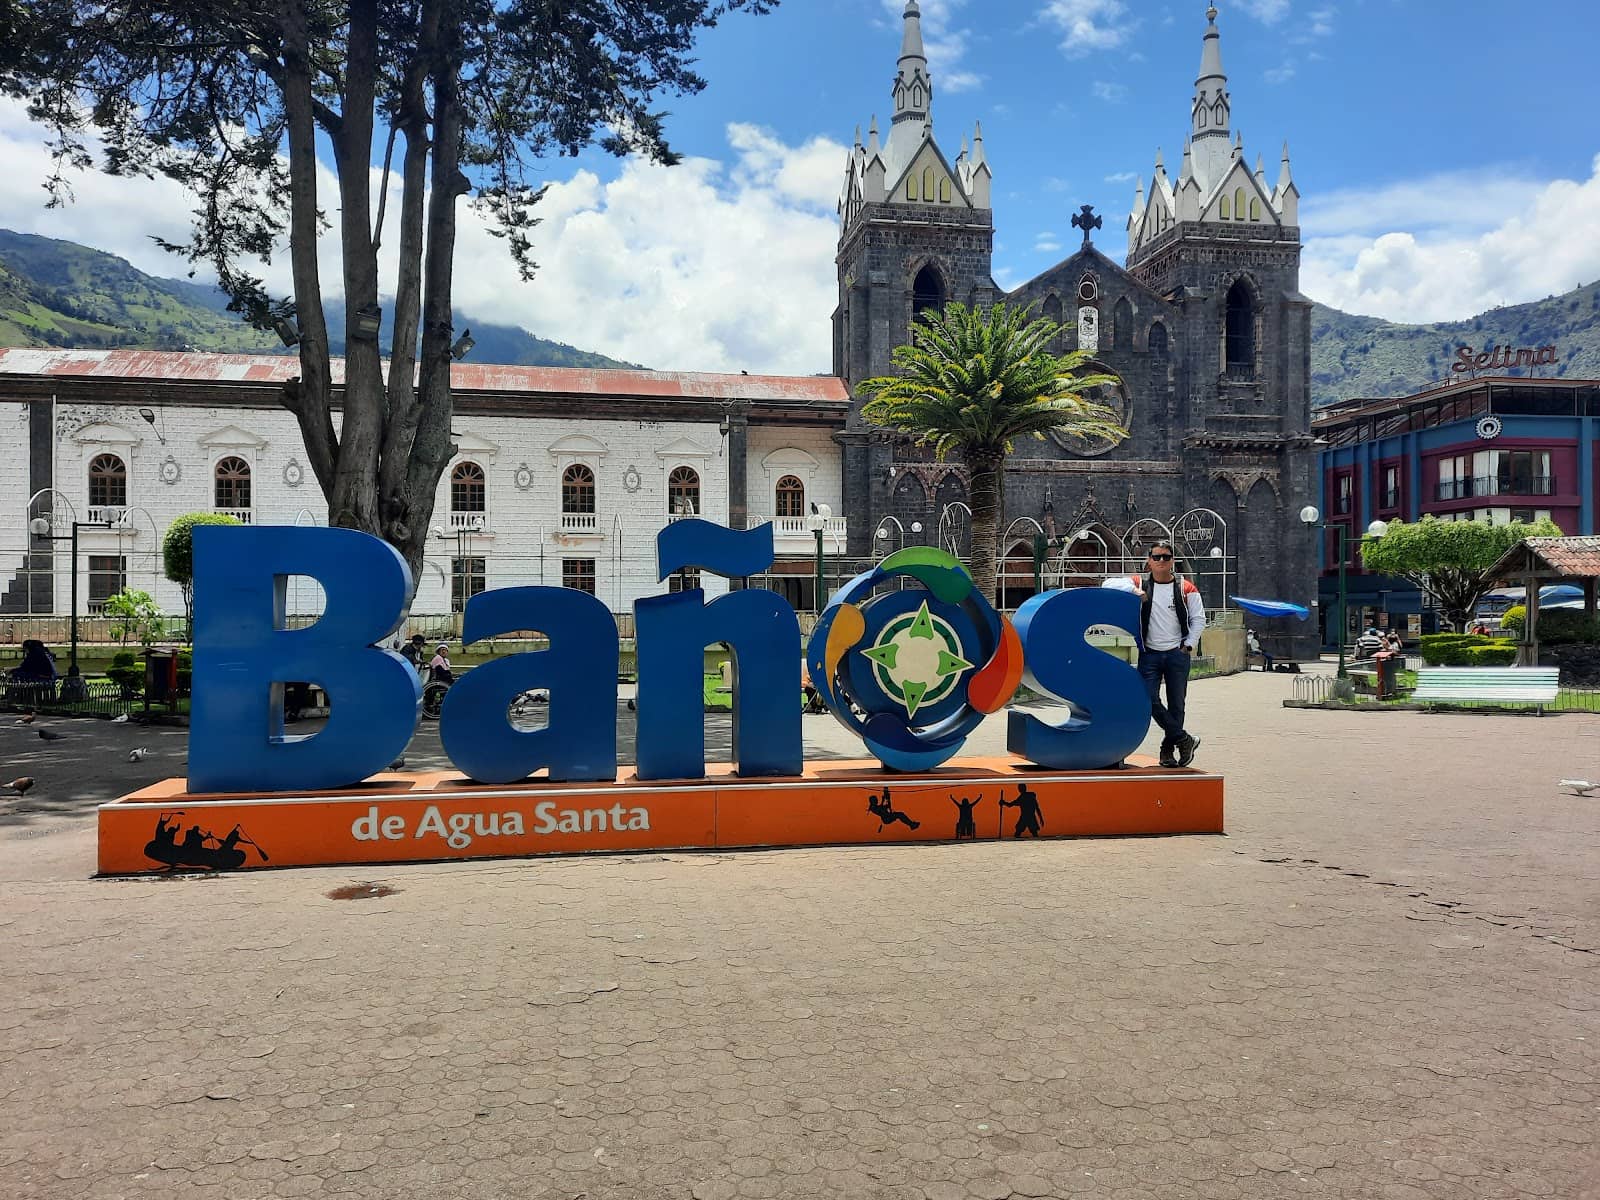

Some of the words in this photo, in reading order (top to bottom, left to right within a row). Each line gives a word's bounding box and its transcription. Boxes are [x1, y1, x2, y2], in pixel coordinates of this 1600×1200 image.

[1452, 344, 1560, 373] Selina
[187, 519, 1152, 793] Baños
[351, 806, 405, 841] de
[414, 805, 525, 849] Agua
[534, 801, 650, 834] Santa
